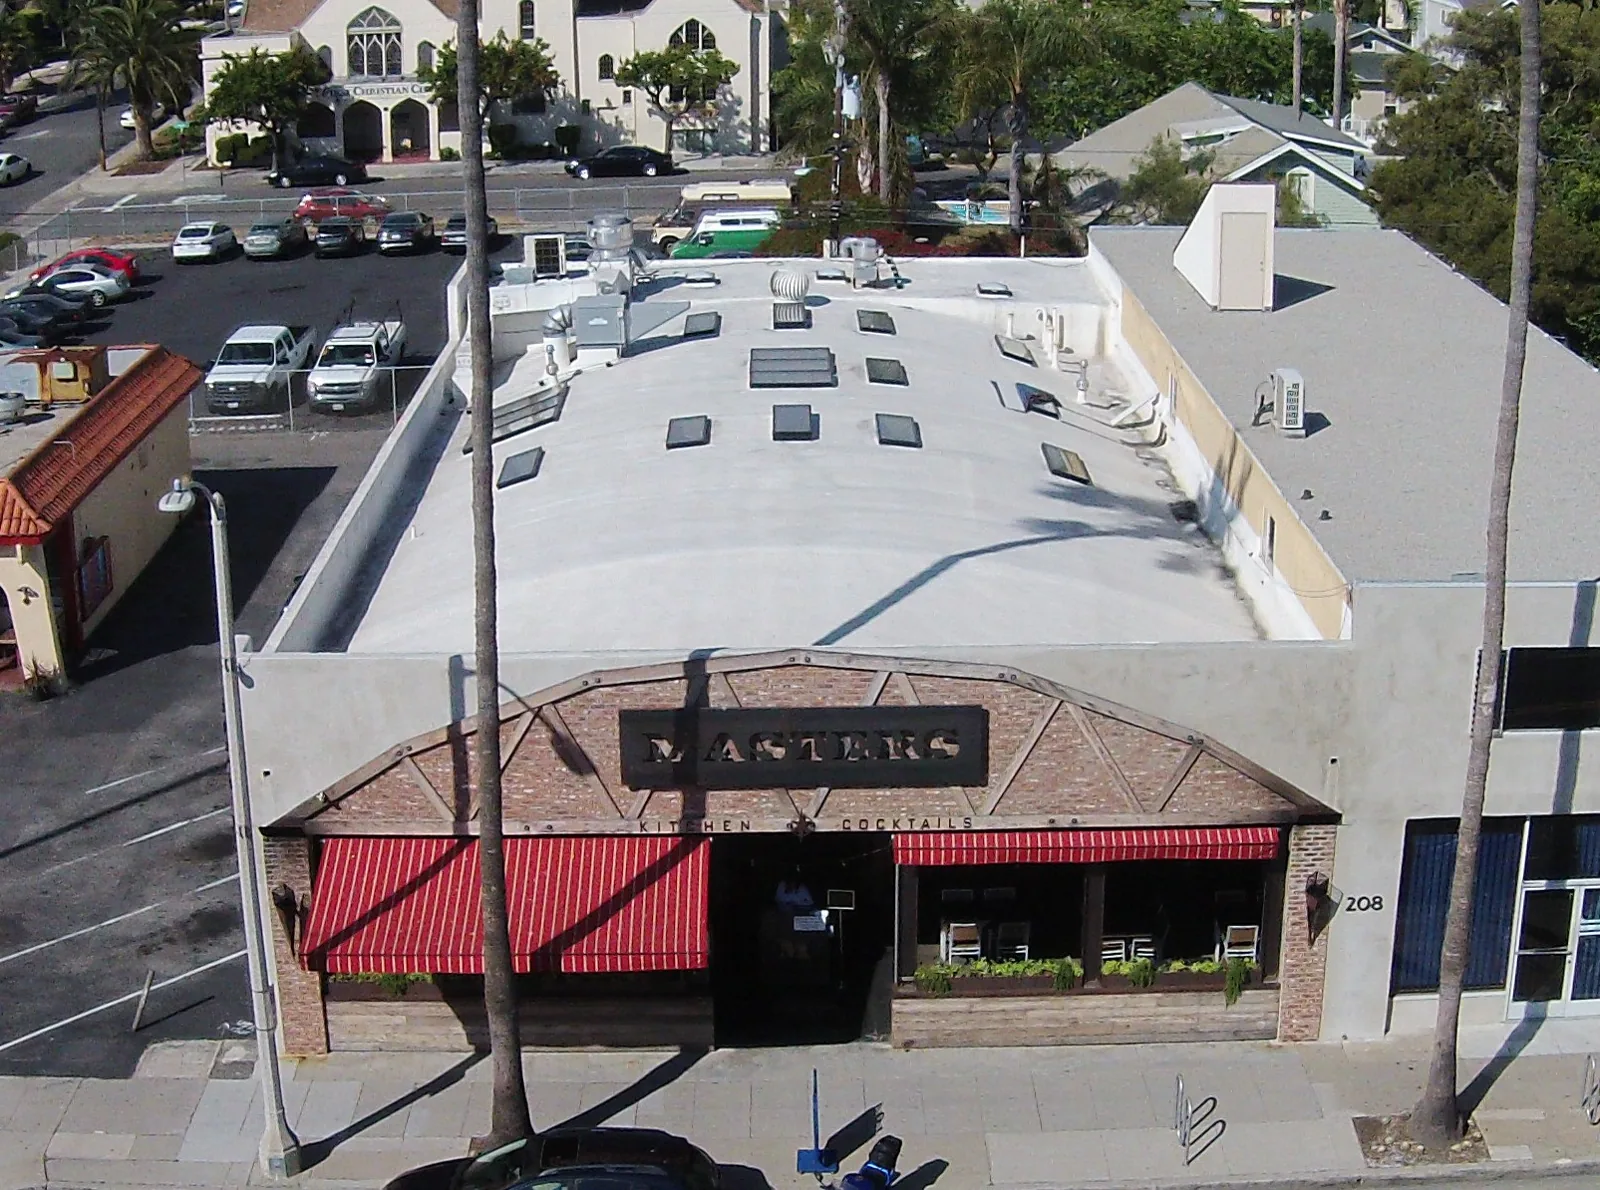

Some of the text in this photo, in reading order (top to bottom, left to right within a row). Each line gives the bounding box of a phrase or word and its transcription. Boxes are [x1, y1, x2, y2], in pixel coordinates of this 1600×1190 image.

[641, 729, 961, 763] MASTERS
[639, 816, 972, 833] KITCHEN COCKTAILS
[1345, 895, 1384, 912] 208
